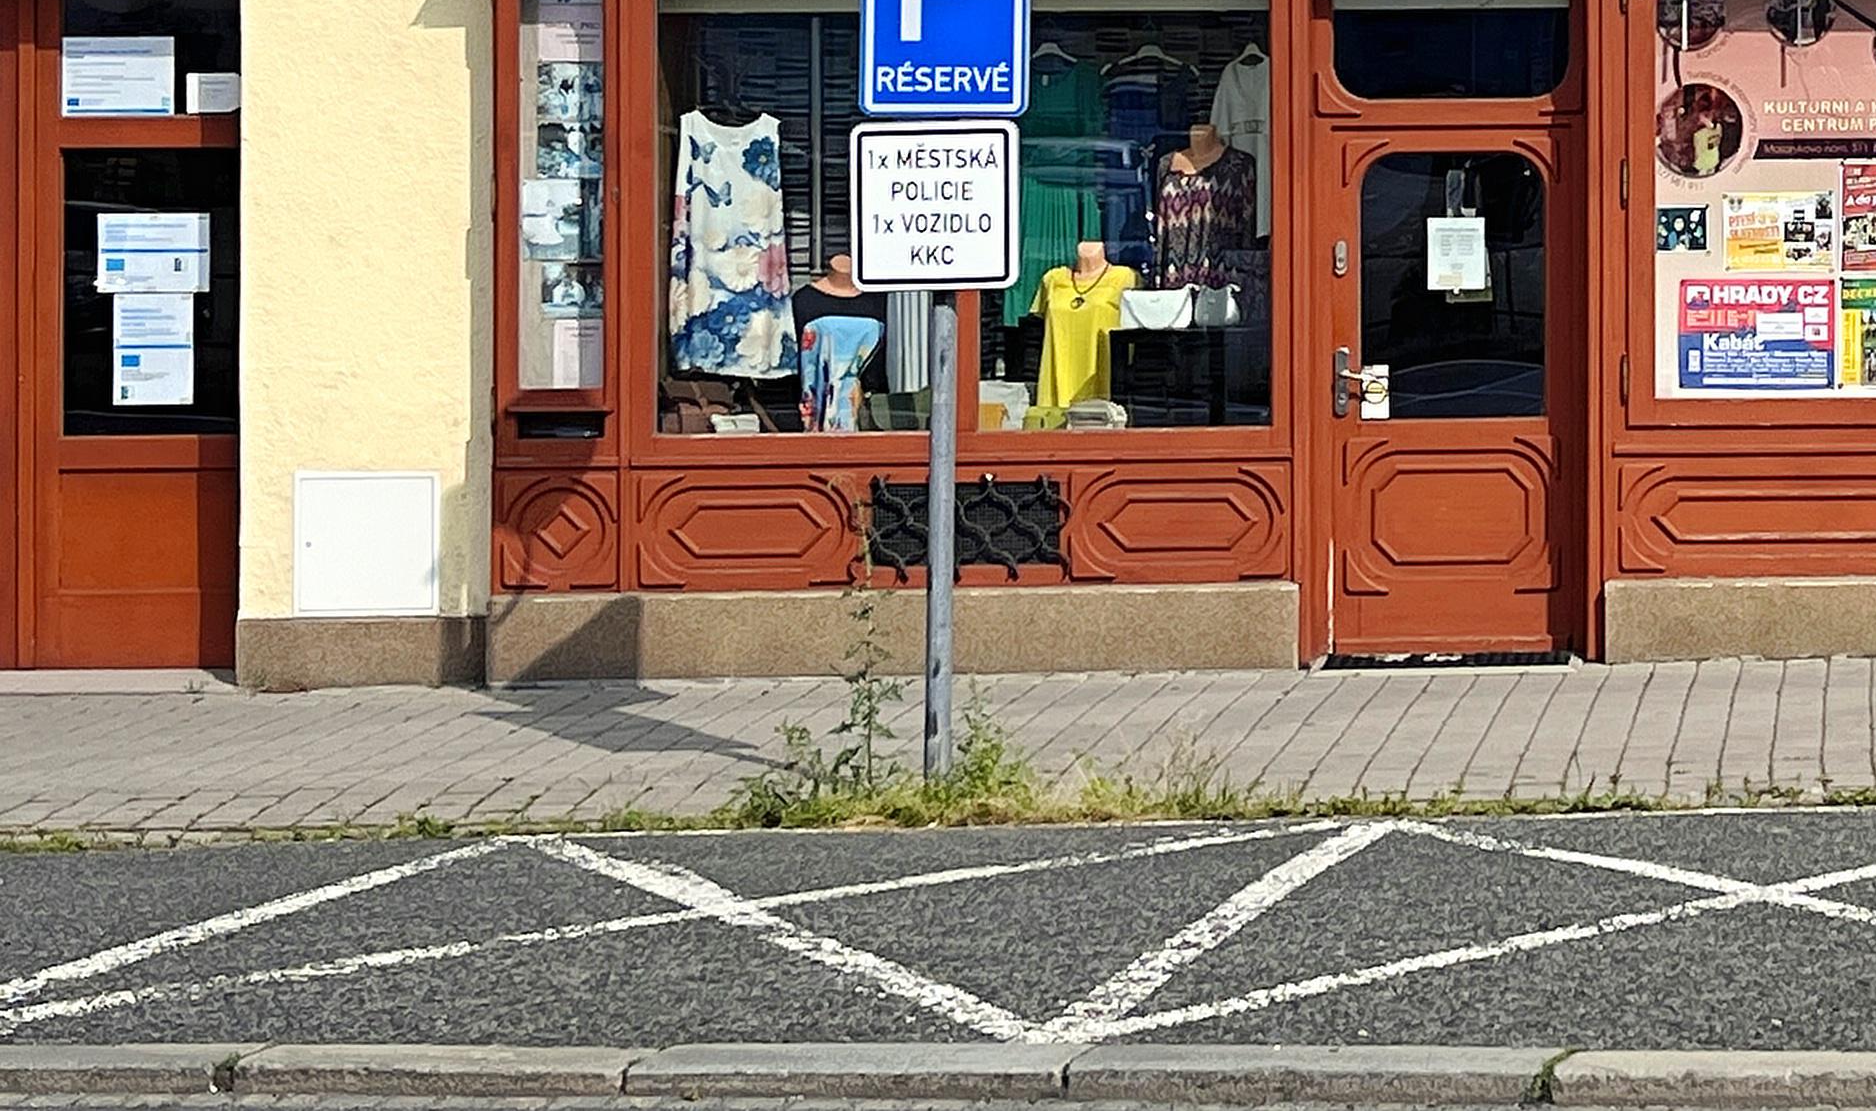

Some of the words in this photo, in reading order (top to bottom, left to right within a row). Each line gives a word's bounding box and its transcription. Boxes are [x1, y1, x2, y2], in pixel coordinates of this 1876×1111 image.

[875, 60, 1011, 94] RÉSERVÉ
[1854, 101, 1866, 113] A
[1781, 117, 1864, 132] CENTRUM
[867, 149, 889, 170] 1x
[895, 142, 999, 170] MĚSTSKÁ
[890, 180, 974, 202] POLICIE
[871, 213, 895, 234] 1x
[902, 213, 992, 235] VOZIDLO
[909, 245, 955, 266] KKC
[1712, 285, 1794, 305] HRADY
[1797, 285, 1830, 305] CZ
[1703, 333, 1765, 351] Kabát
